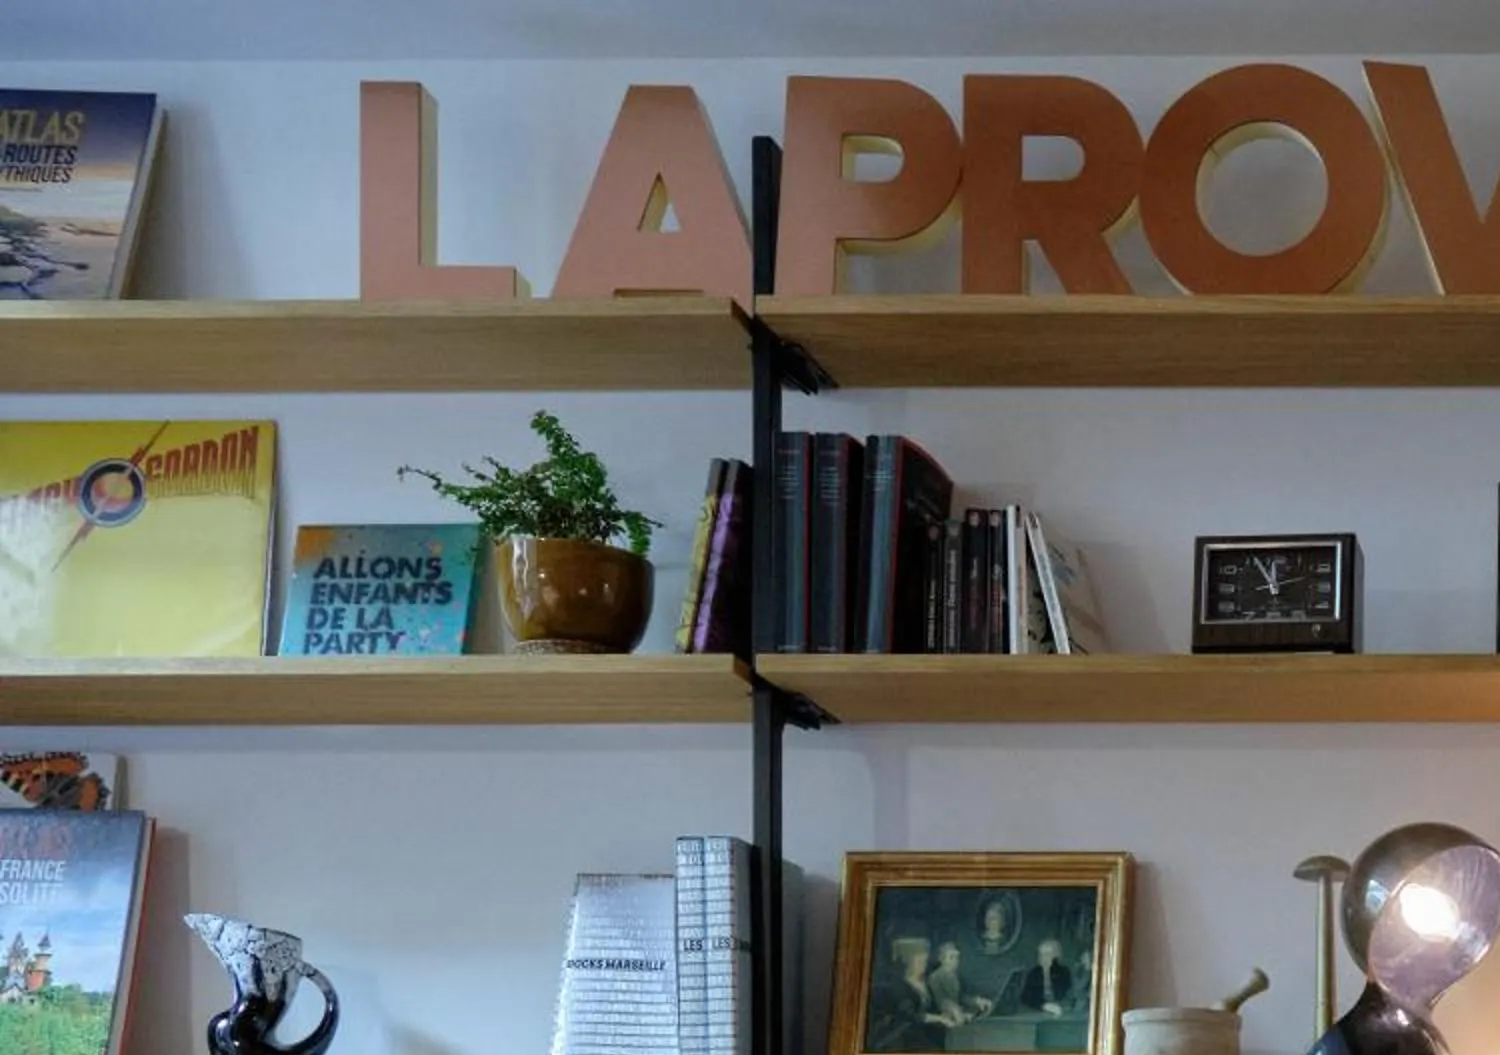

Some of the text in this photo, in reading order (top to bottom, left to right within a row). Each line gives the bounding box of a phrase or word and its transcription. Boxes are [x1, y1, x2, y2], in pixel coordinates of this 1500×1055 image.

[4, 143, 78, 165] ROUTES
[313, 557, 443, 580] ALLONS
[309, 582, 454, 606] ENFANTS
[306, 607, 395, 631] DE LA
[303, 631, 406, 655] PARTY
[0, 859, 66, 881] FRANCE
